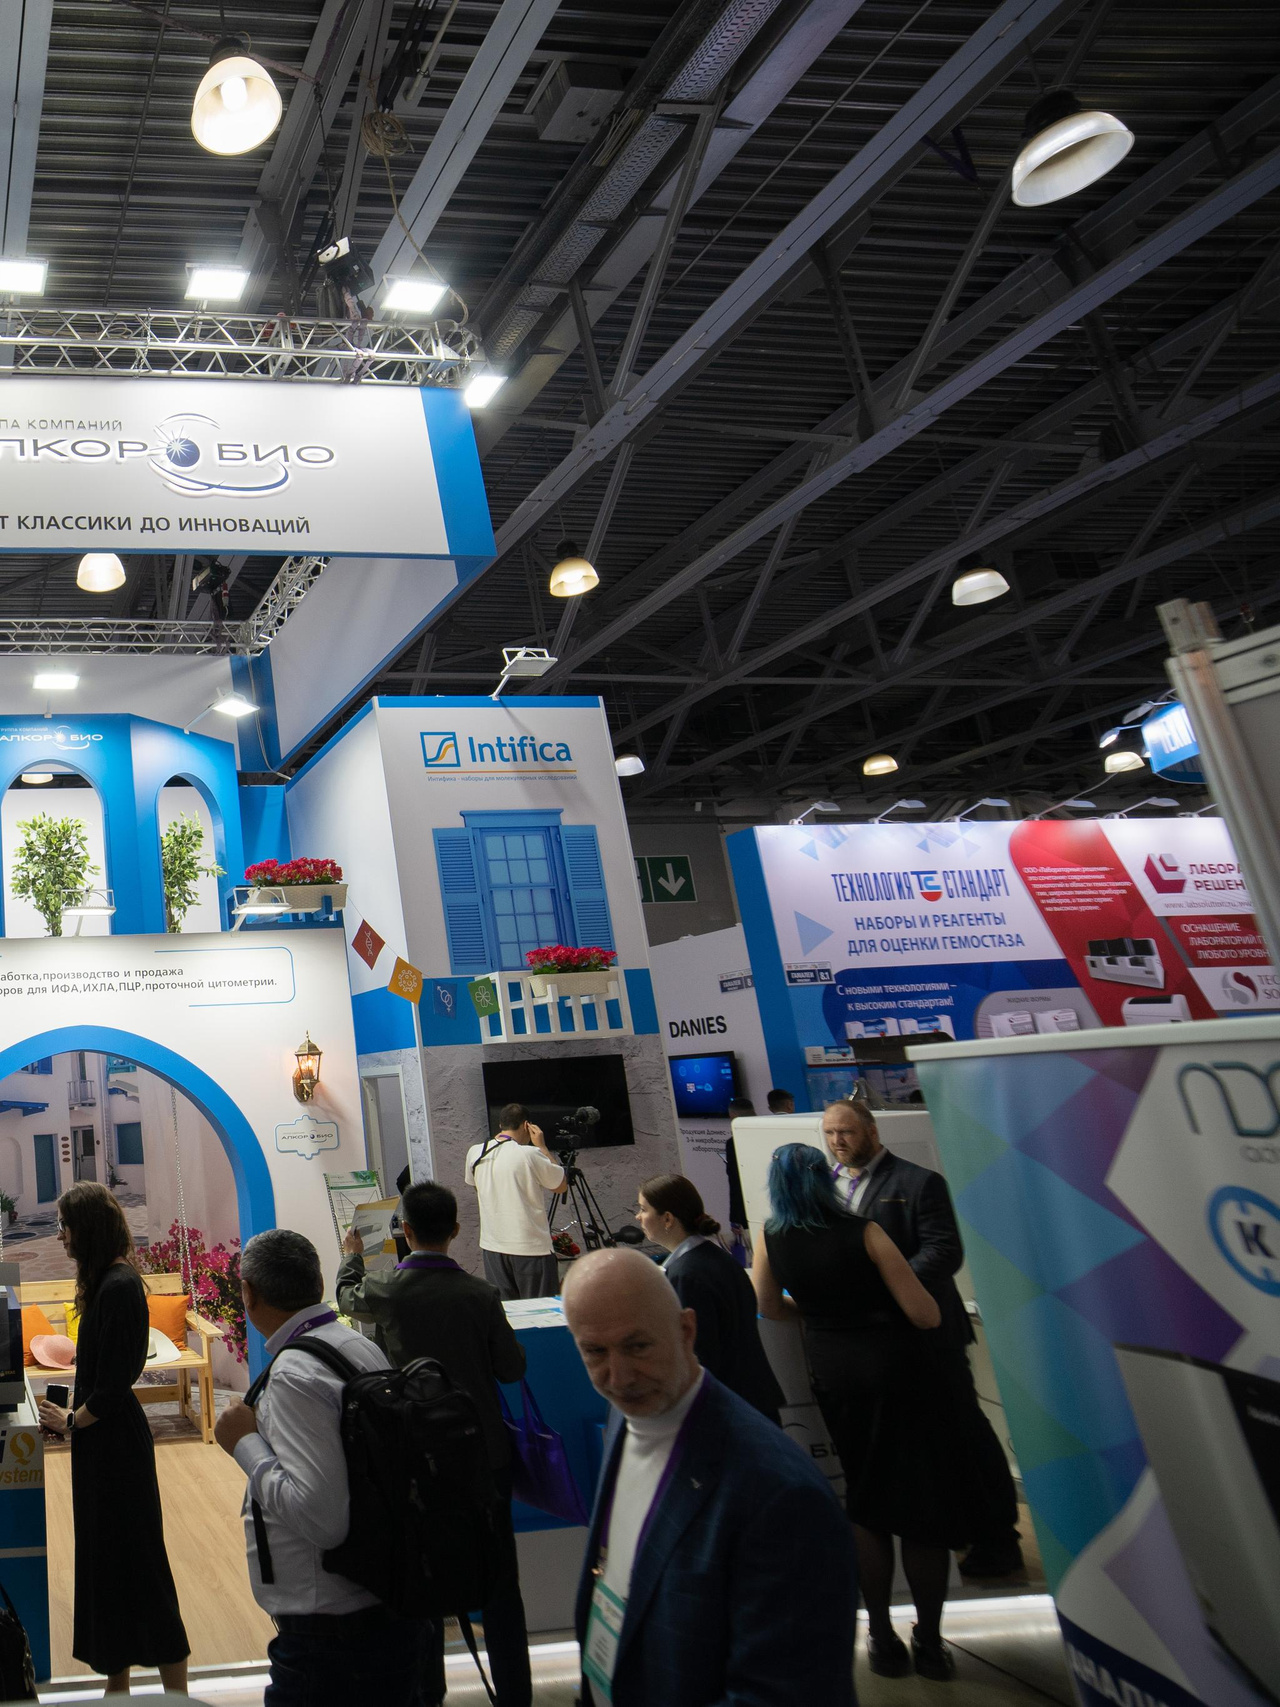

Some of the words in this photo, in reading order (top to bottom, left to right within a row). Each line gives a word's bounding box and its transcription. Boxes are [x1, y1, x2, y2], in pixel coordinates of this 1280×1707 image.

[28, 418, 122, 431] КОМПАНИЙ
[217, 442, 336, 464] БИО
[18, 514, 132, 531] КЛАССИКИ
[140, 517, 170, 533] ДО
[178, 516, 310, 535] ИННОВАЦИЙ
[0, 734, 53, 742] АЛКОР
[468, 736, 573, 763] Intifica
[831, 871, 915, 902] ТЕХНОЛОГИЯ
[943, 869, 1010, 902] СТАНДАРТ
[854, 915, 917, 931] НАБОРЫ
[920, 915, 930, 928] И
[934, 912, 1006, 928] РЕАГЕНТЫ
[1180, 922, 1242, 934] ОСНАЩЕНИЕ
[848, 939, 877, 956] ДЛЯ
[880, 936, 939, 954] ОЦЕНКИ
[942, 933, 1025, 950] ГЕМОСТАЗА
[1189, 933, 1258, 946] ЛАБОРАТОРИЙ
[1197, 949, 1238, 960] ЛЮБОГО
[124, 970, 131, 978] и
[135, 968, 183, 979] продажа
[27, 985, 47, 995] для
[208, 978, 277, 988] цитометрии.
[836, 984, 844, 995] С
[845, 985, 883, 995] новыми
[884, 982, 949, 993] технологиями
[847, 1001, 855, 1011] к
[855, 1000, 897, 1010] высоким
[898, 996, 954, 1010] стандартам!
[669, 1015, 727, 1038] DANIES
